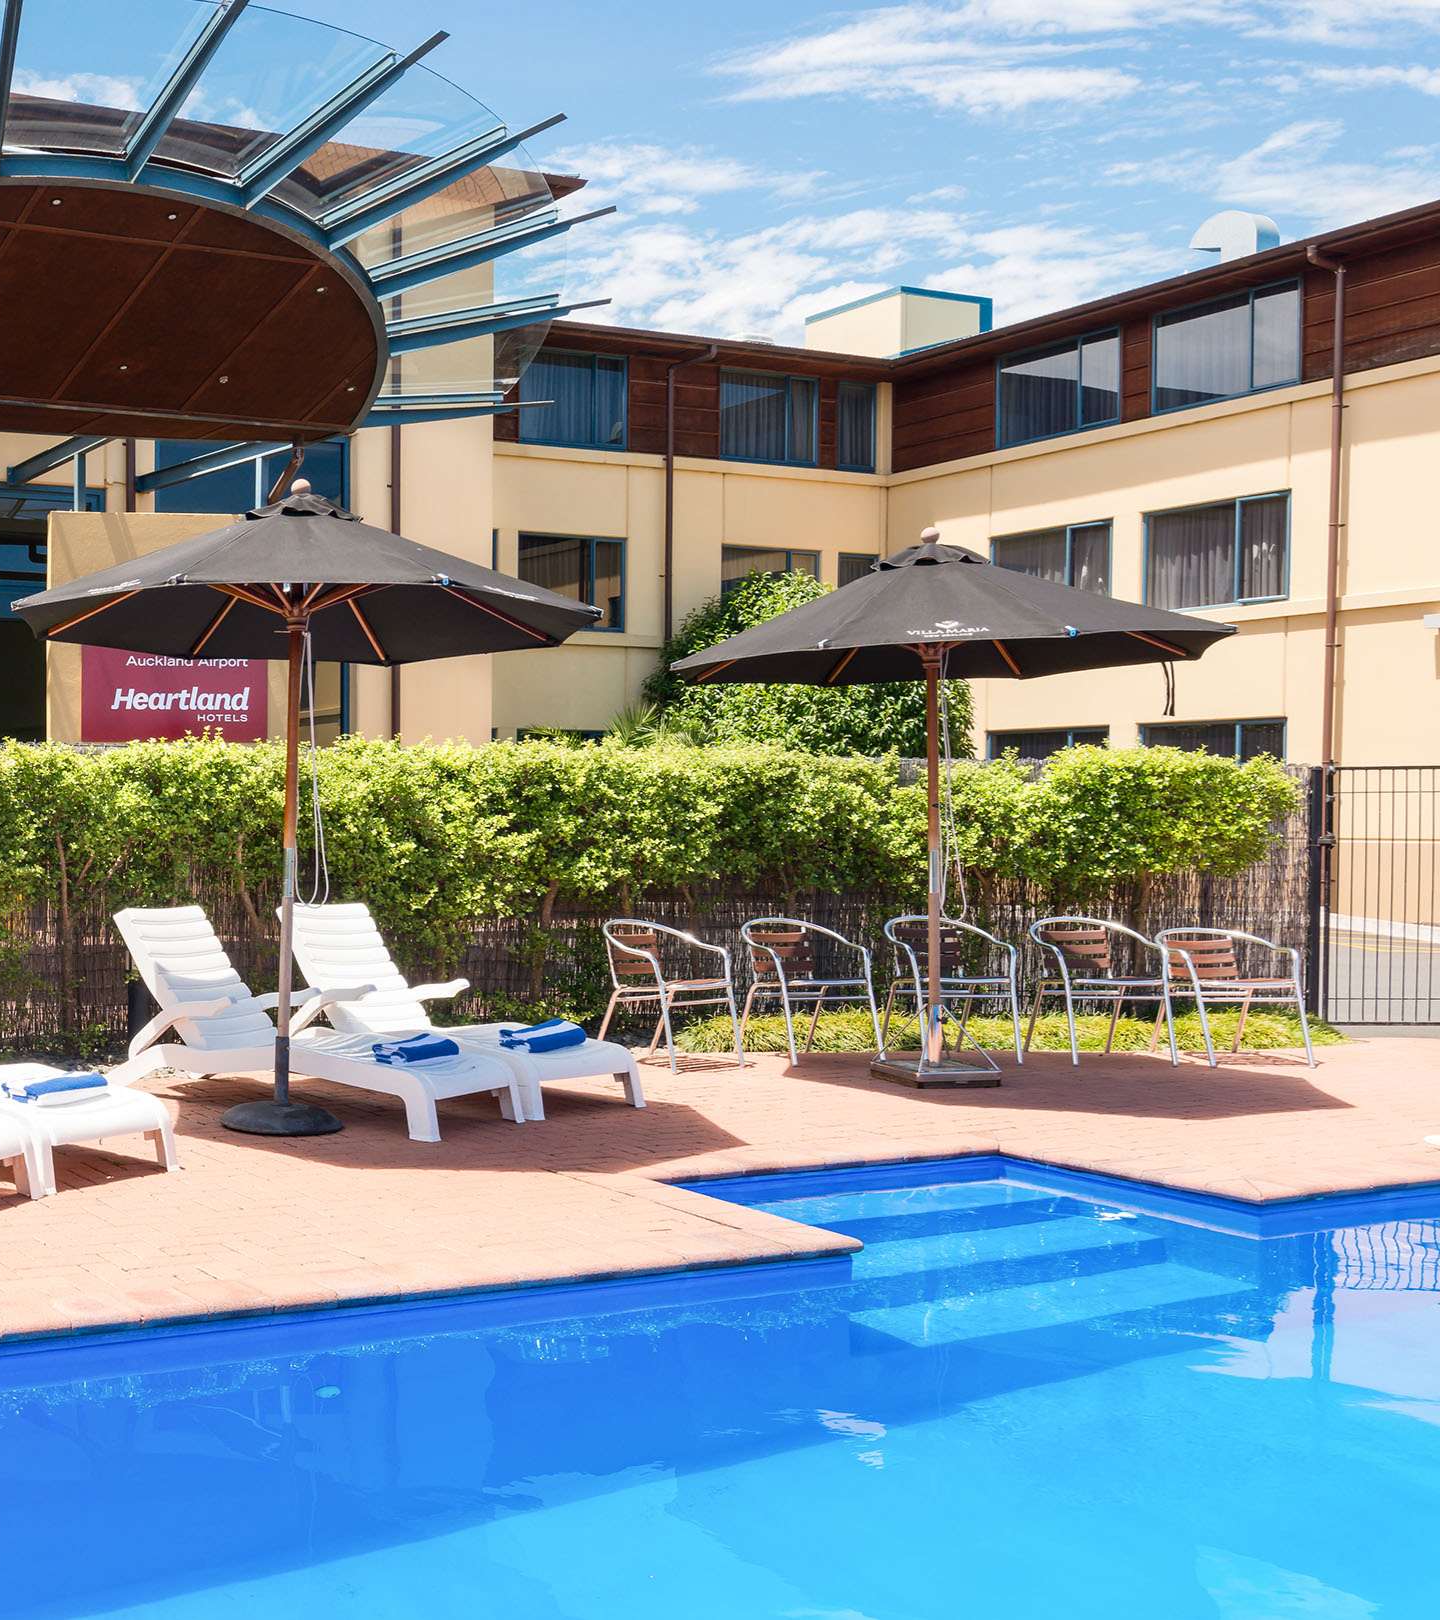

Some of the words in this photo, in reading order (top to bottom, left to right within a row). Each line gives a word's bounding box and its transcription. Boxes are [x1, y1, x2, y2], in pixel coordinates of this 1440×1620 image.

[125, 655, 194, 667] Auckland
[197, 658, 249, 669] Airport
[111, 686, 250, 711] Heartland
[197, 713, 248, 722] HOTELS
